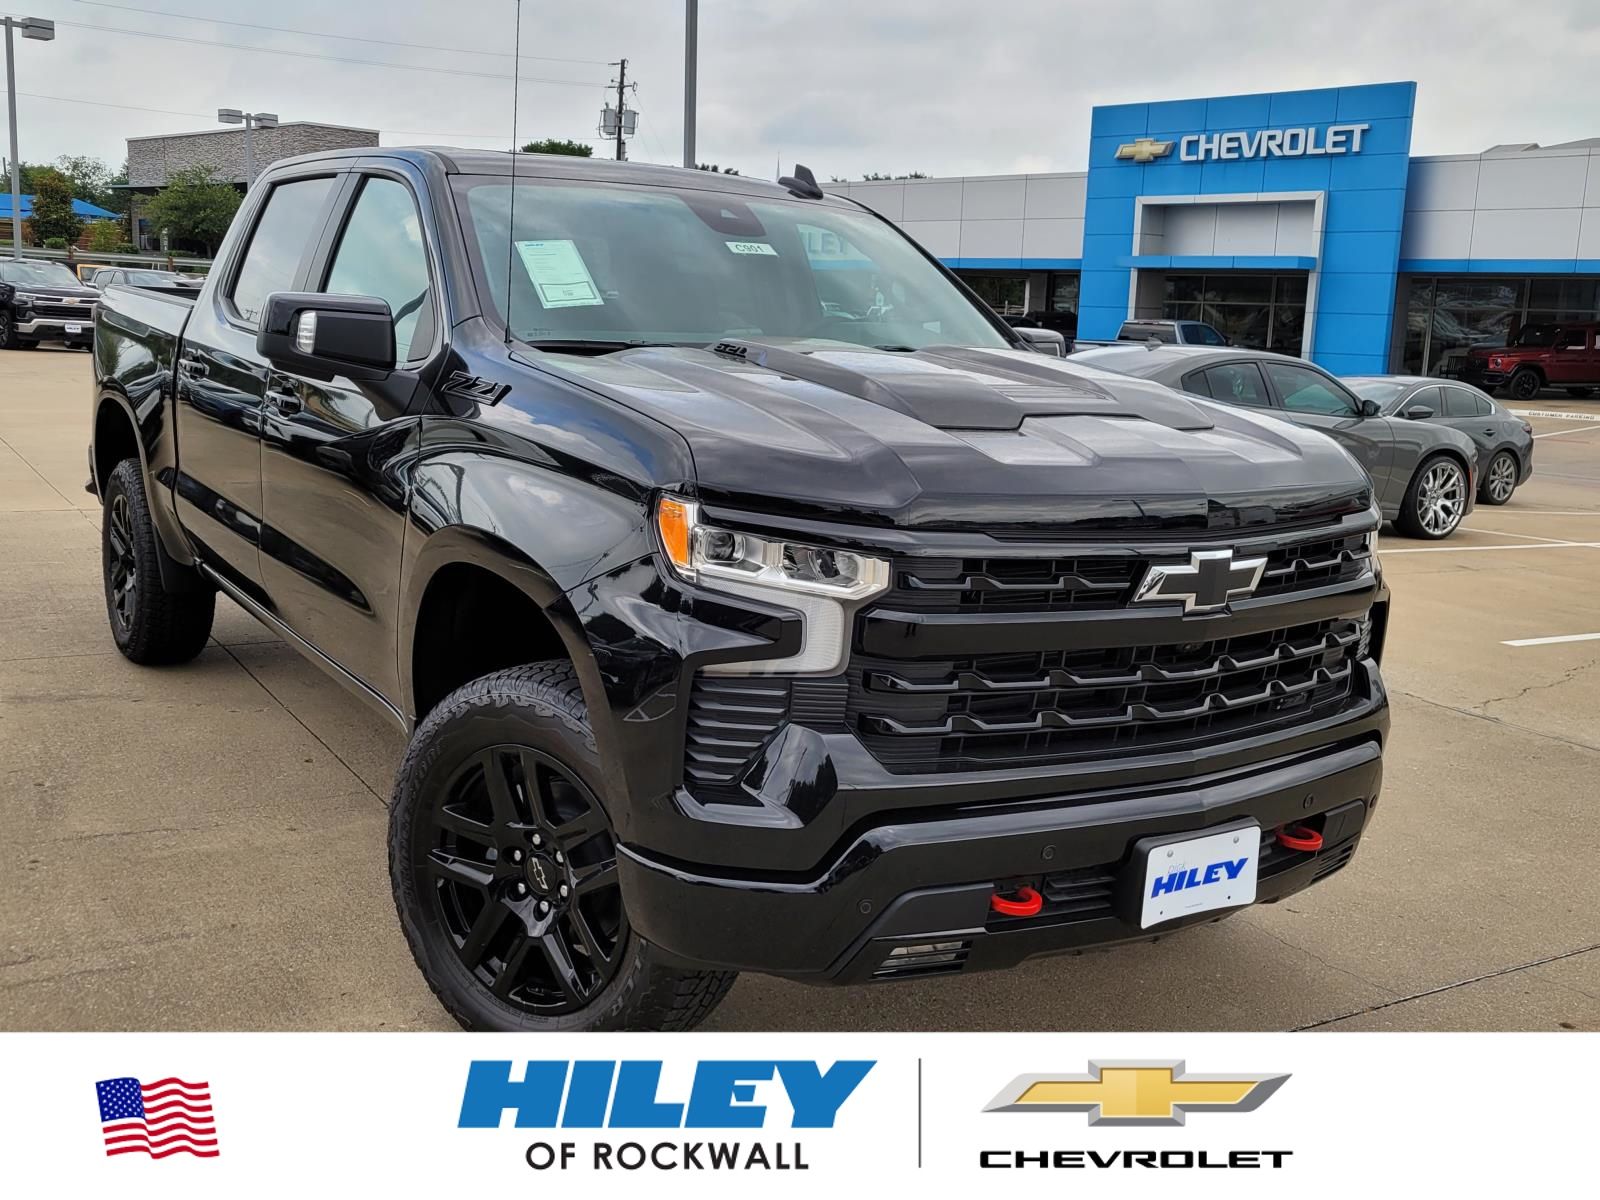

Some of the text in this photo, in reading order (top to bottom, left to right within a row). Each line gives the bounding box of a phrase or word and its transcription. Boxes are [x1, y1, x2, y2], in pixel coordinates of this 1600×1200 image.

[1179, 123, 1369, 162] CHEVROLET
[441, 370, 512, 407] Z71
[1150, 857, 1249, 899] HILEY
